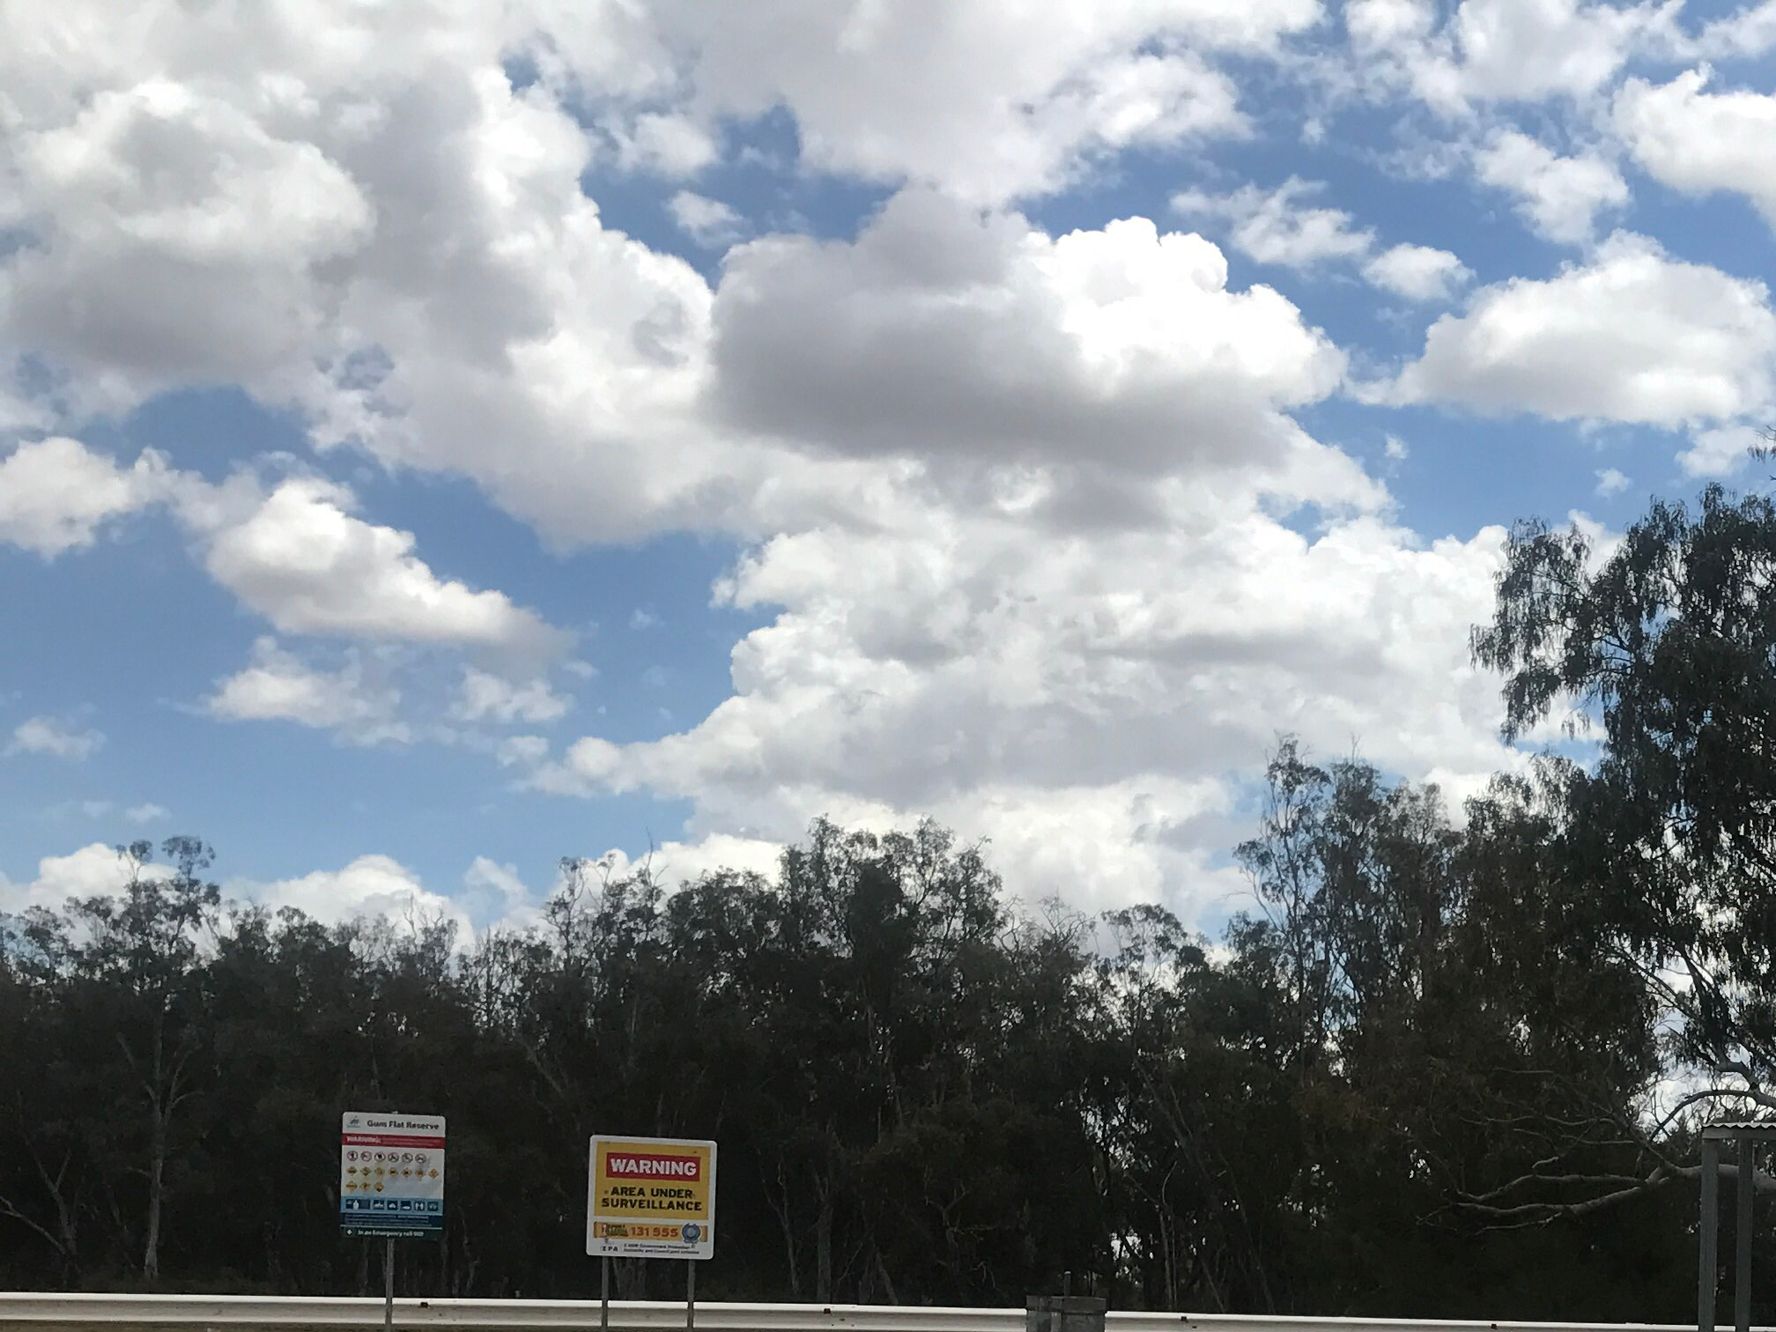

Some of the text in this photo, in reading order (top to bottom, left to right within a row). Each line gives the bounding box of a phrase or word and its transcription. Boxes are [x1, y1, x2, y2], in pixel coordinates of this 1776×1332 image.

[389, 1120, 404, 1128] Flat
[406, 1121, 439, 1130] Reserve
[610, 1158, 697, 1176] WARNING
[611, 1186, 694, 1199] AREA UNDER
[601, 1197, 702, 1211] SURVEILLANCE
[631, 1226, 649, 1236] 131
[652, 1227, 679, 1237] 555
